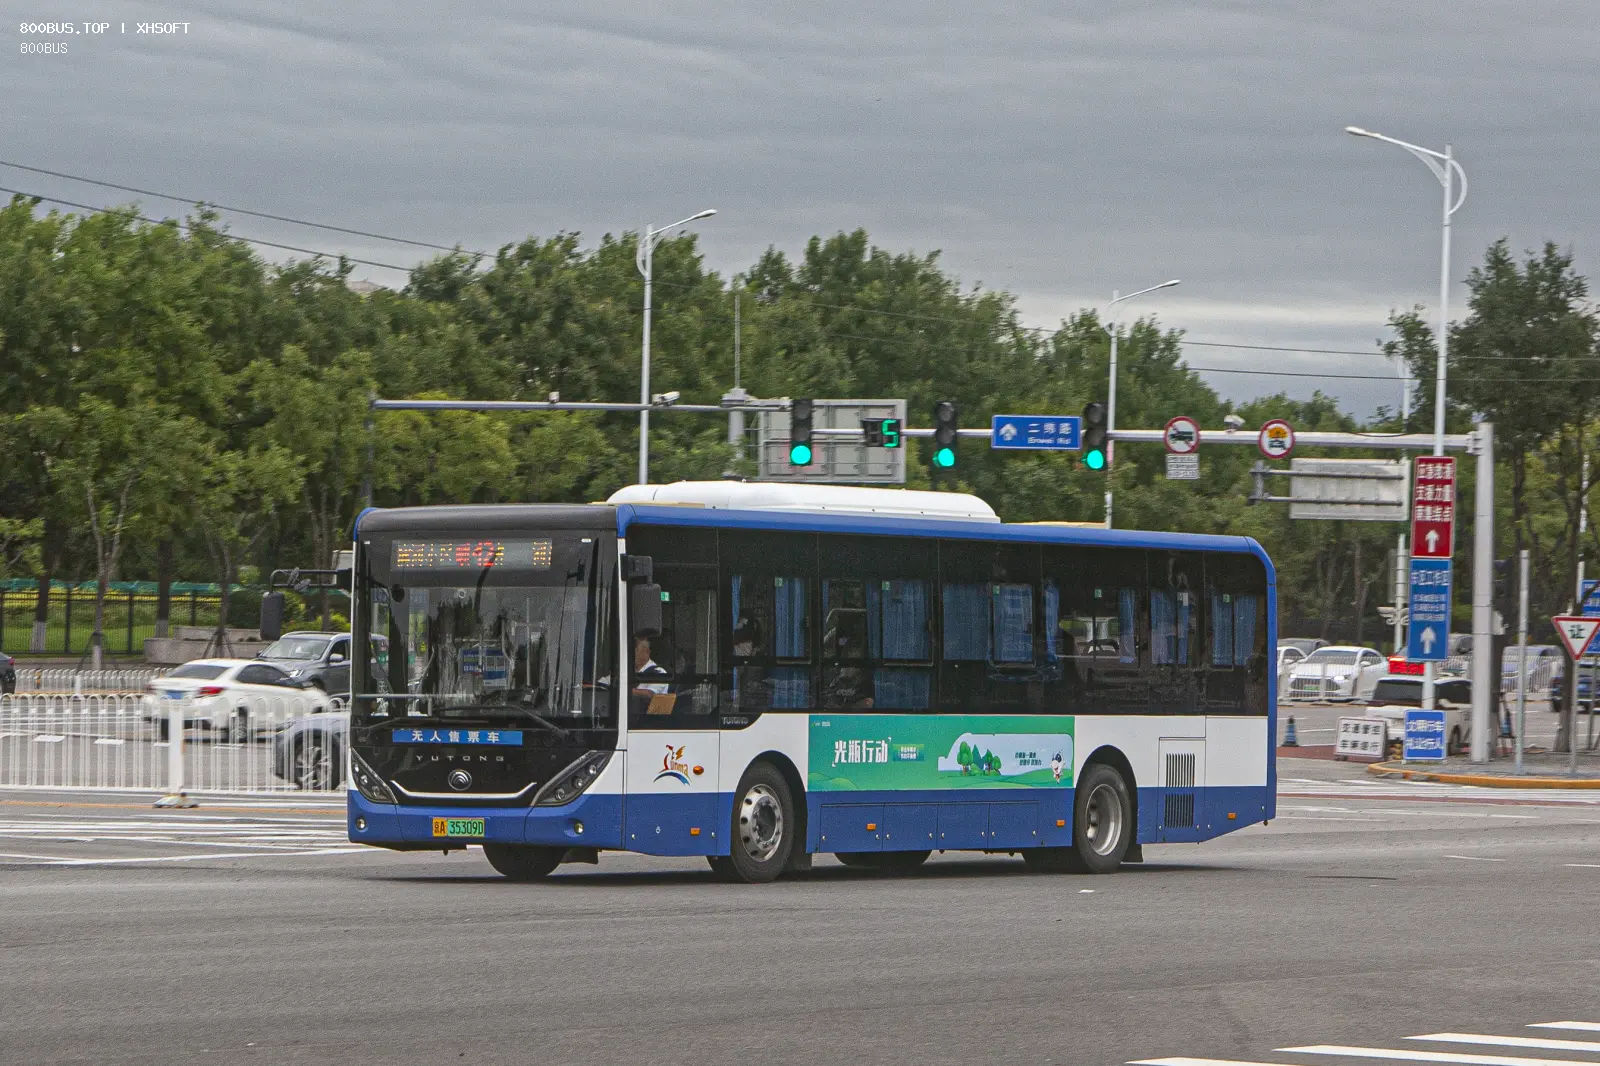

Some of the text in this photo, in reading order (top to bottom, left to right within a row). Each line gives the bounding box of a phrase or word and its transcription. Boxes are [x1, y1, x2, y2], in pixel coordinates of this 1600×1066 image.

[1568, 624, 1586, 639] 让
[411, 730, 501, 744] 无人售票车
